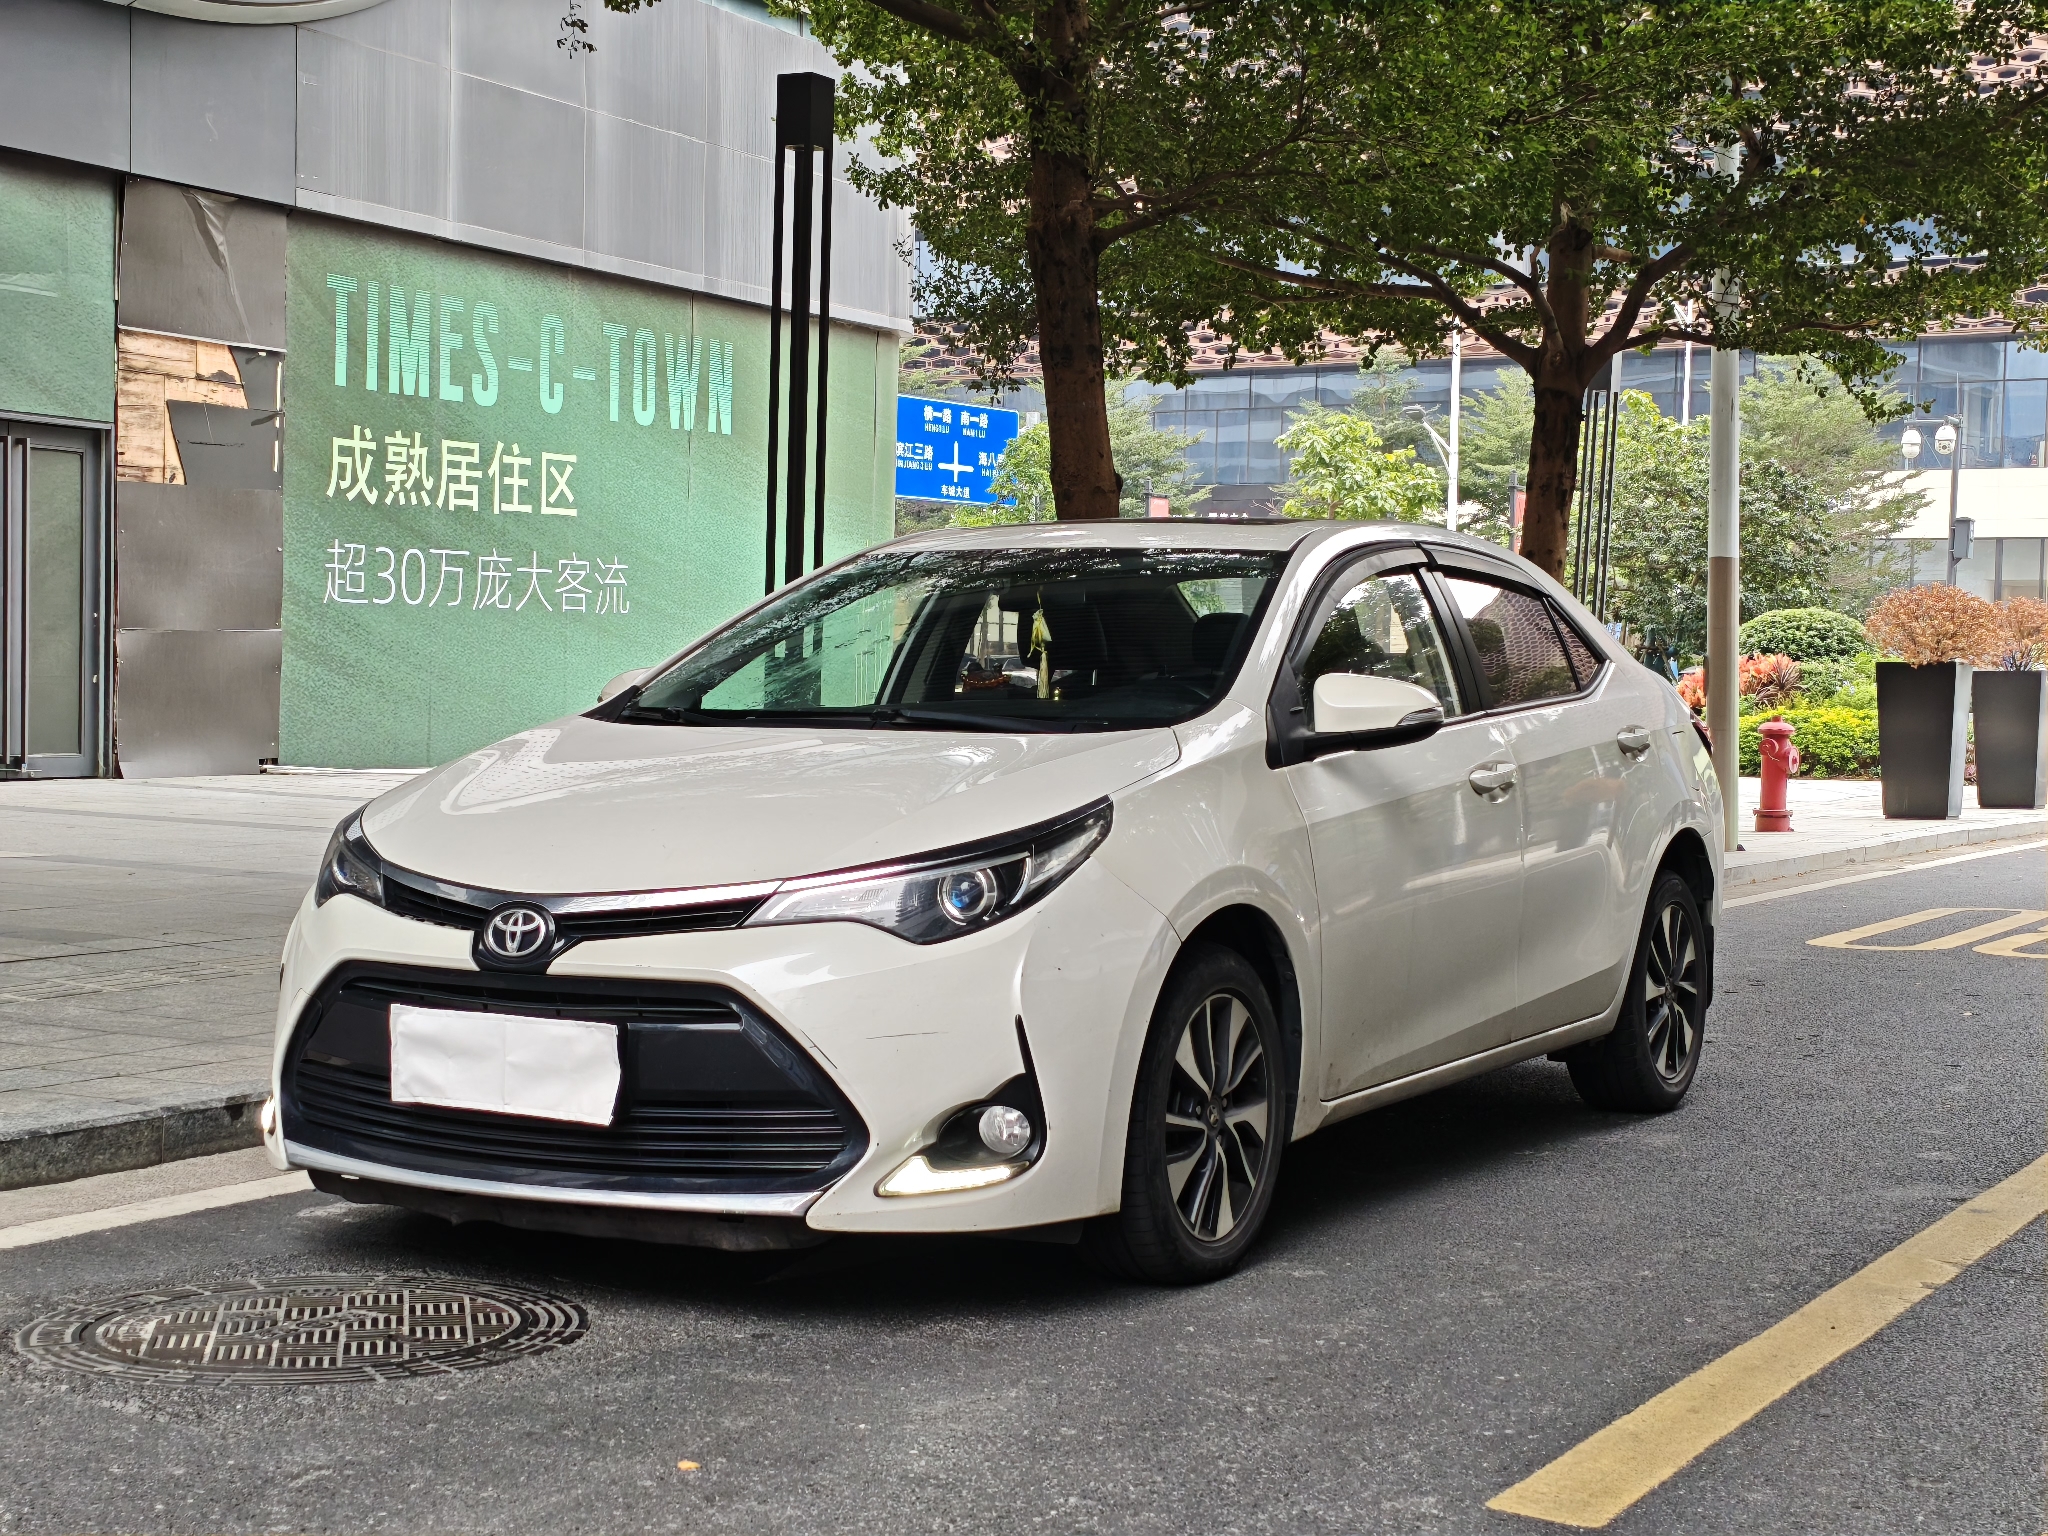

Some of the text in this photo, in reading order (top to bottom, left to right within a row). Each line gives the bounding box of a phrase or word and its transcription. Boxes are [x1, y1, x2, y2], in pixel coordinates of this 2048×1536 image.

[327, 273, 735, 436] TIMES-C-TOWN
[961, 411, 988, 428] 南一路
[326, 424, 579, 518] 成熟居住区
[323, 538, 630, 616] 超30万庞大客流
